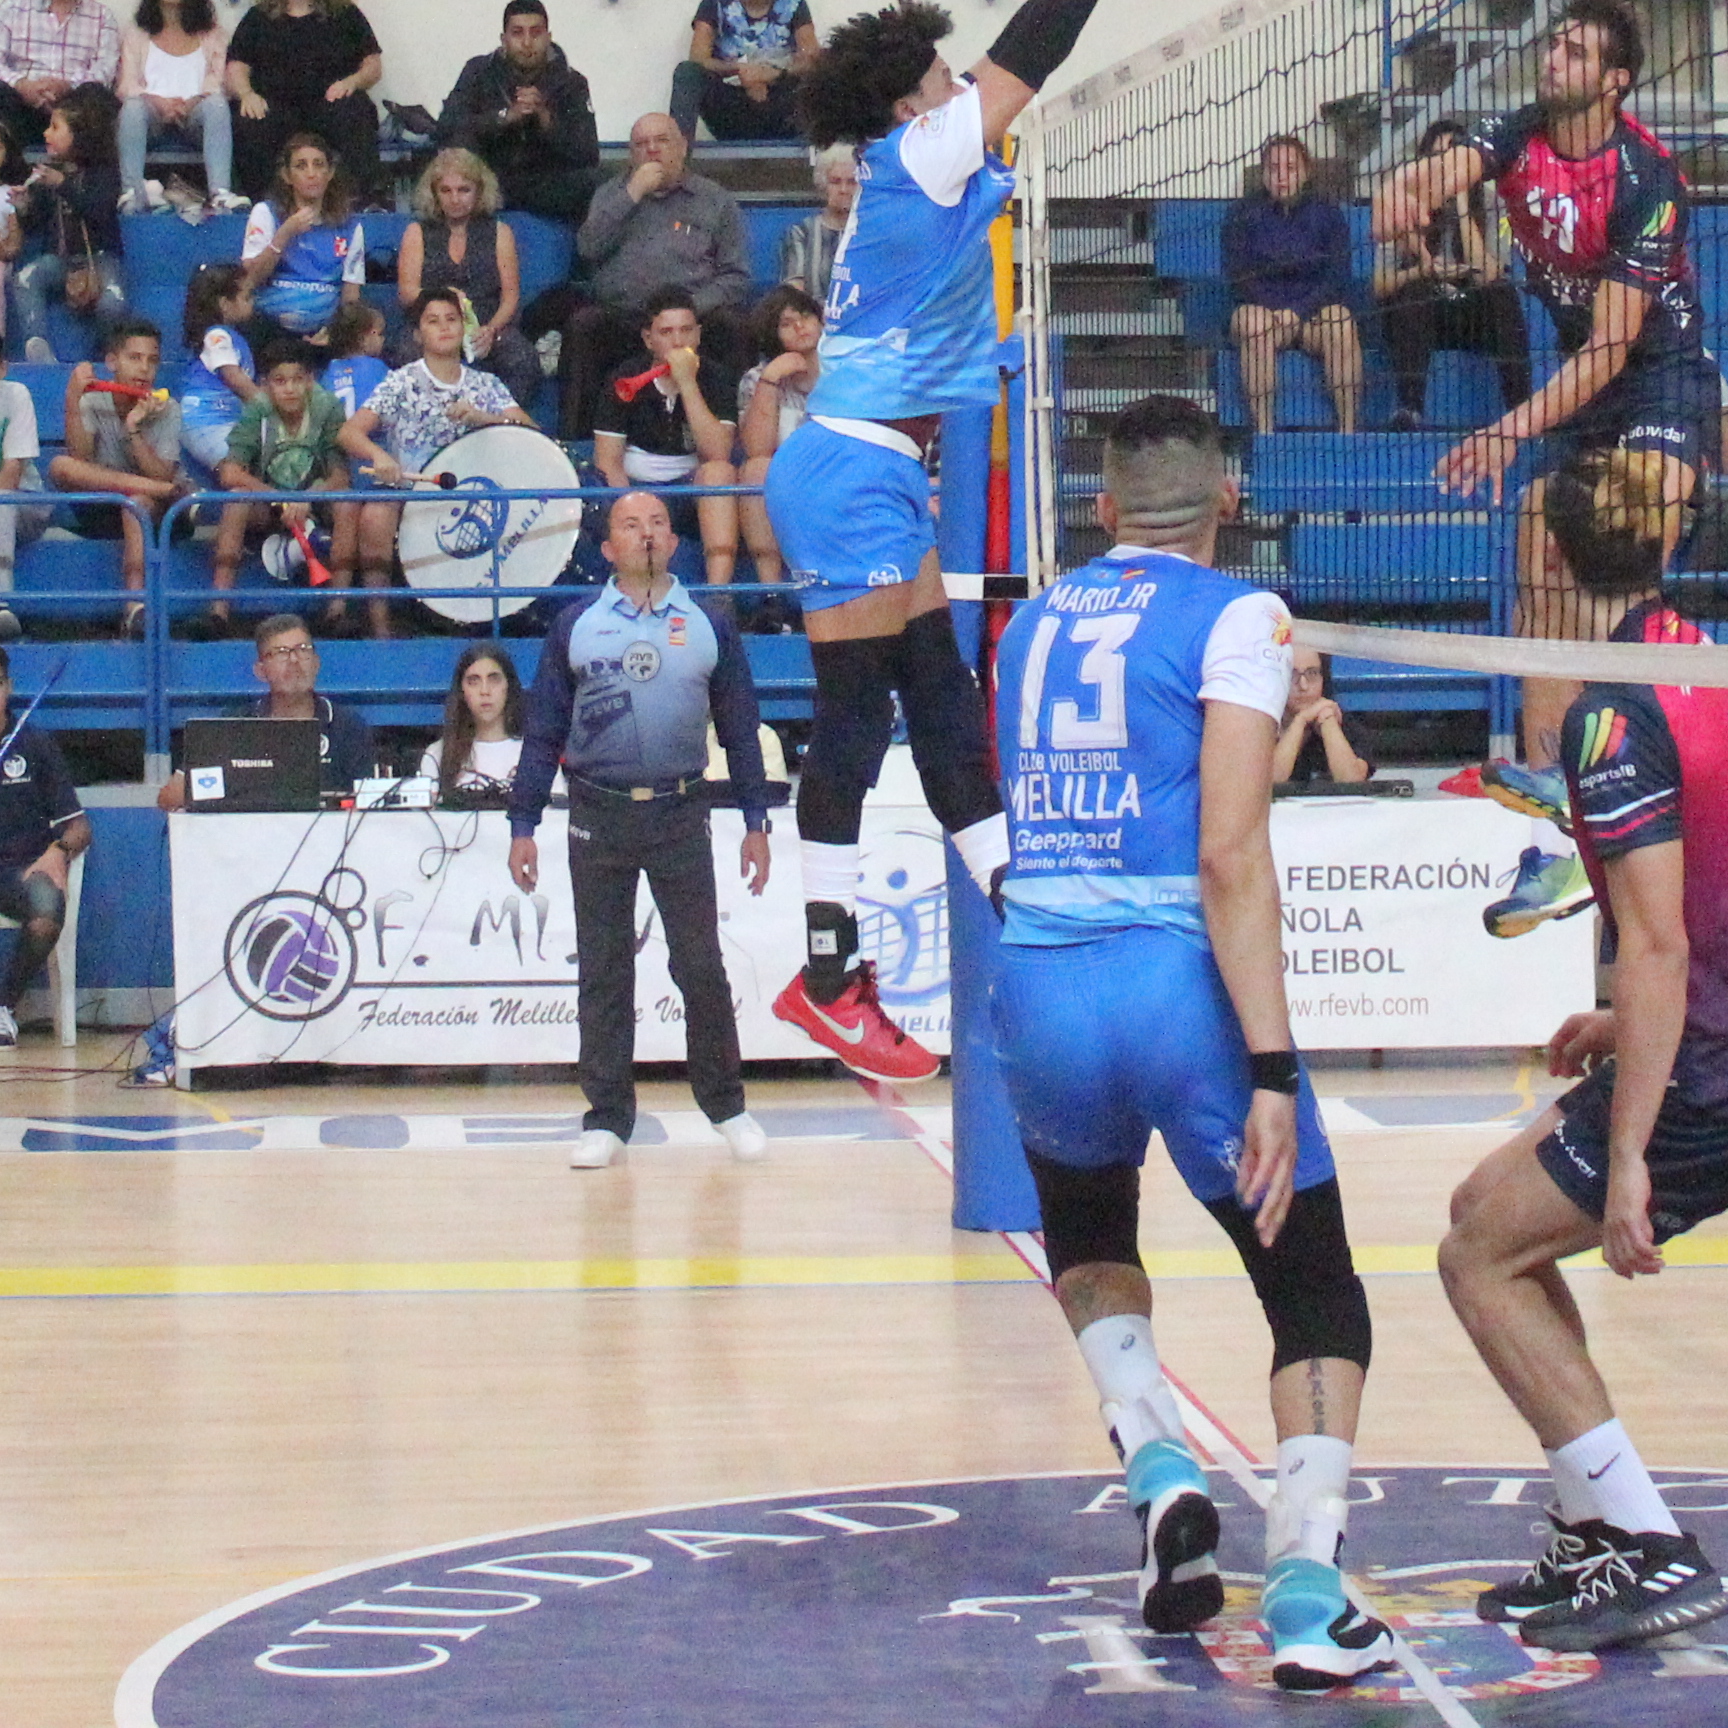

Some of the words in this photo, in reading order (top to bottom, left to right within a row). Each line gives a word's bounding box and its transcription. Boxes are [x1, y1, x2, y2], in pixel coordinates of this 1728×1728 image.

[1045, 582, 1117, 610] MARIO
[1118, 580, 1159, 610] JR
[1018, 612, 1134, 750] 13
[230, 758, 274, 769] TOSHIBA
[1048, 752, 1123, 773] VOLEIBOL
[1008, 773, 1142, 823] MELILLA
[1286, 861, 1491, 893] FEDERACIÓN
[1280, 901, 1364, 937] ÑOLA
[358, 998, 480, 1033] Federación
[253, 1497, 962, 1682] CIUDAD
